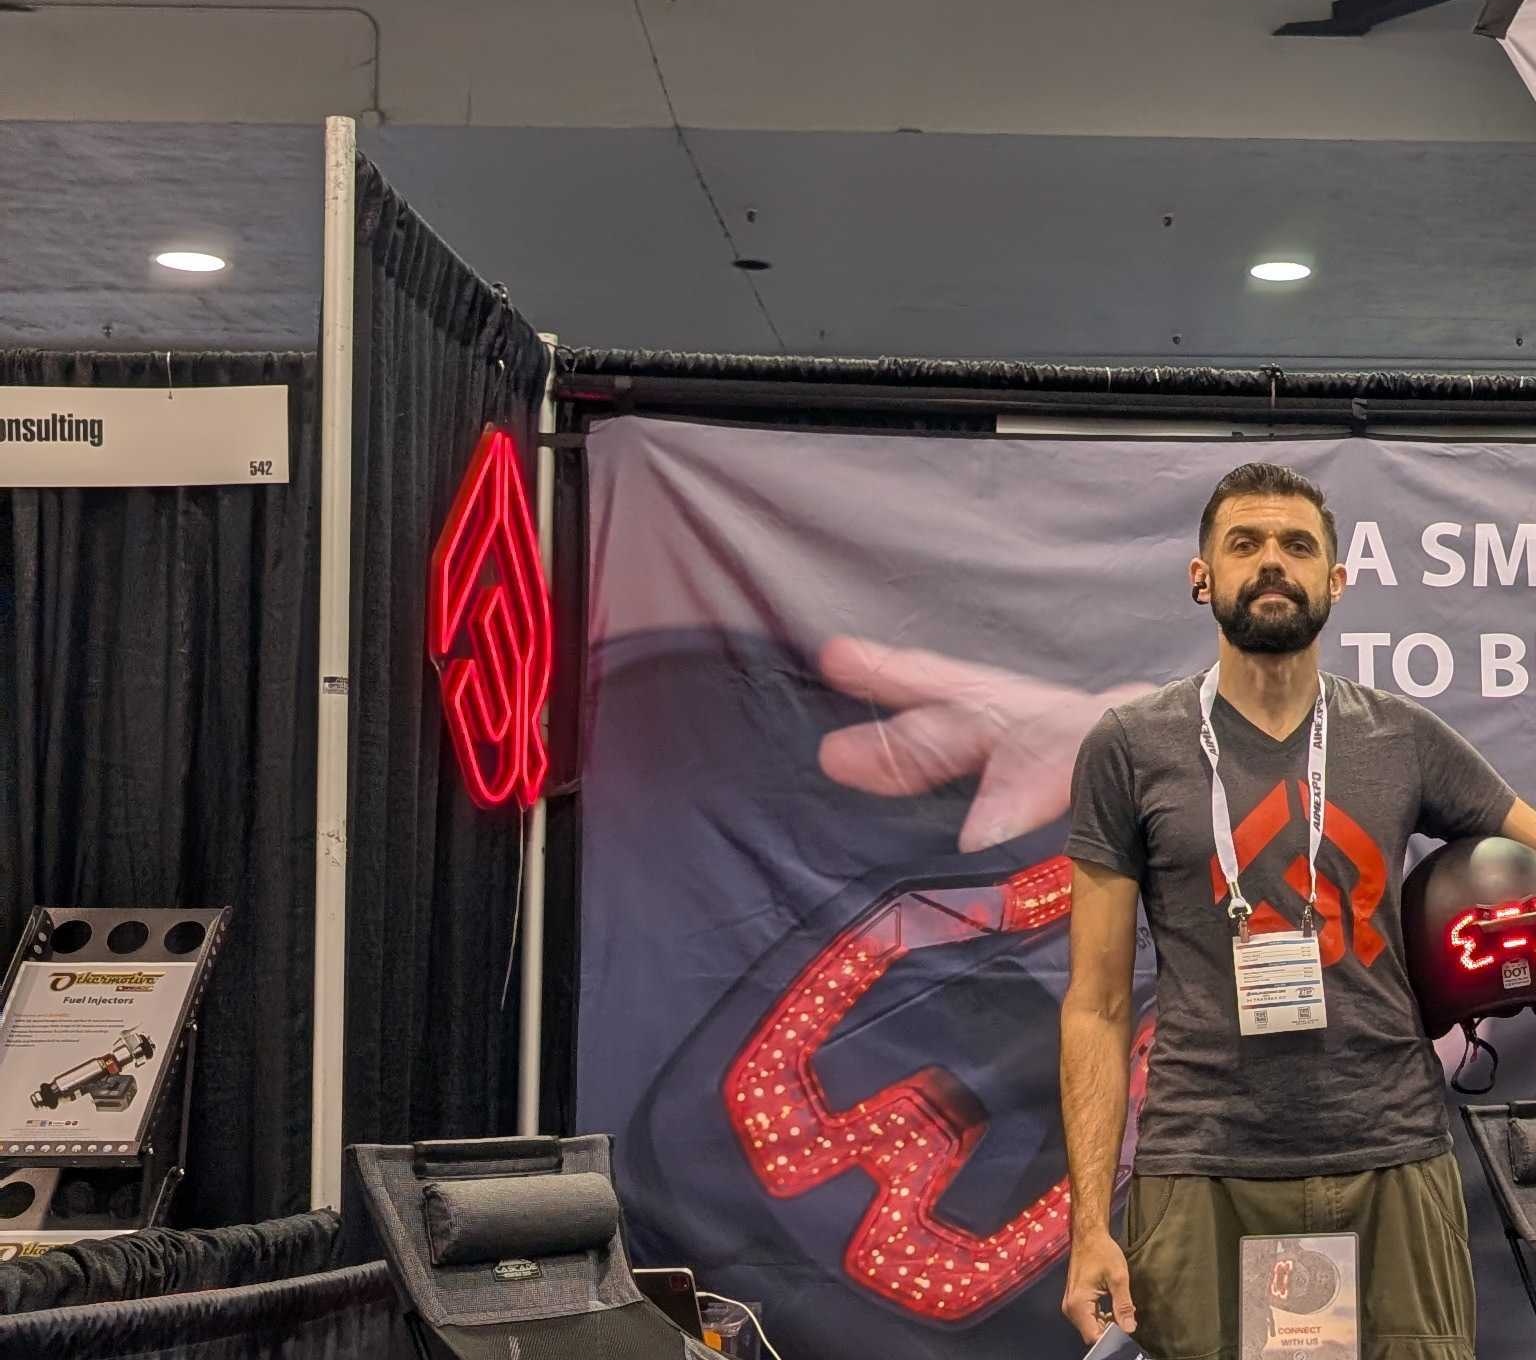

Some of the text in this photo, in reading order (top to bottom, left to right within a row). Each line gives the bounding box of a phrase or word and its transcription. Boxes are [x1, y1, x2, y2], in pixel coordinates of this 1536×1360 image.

[250, 460, 273, 476] 542
[1345, 521, 1399, 587] A
[1341, 632, 1454, 698] TO
[1312, 771, 1323, 832] AIMEXPO
[1504, 966, 1527, 979] DOT
[62, 996, 134, 1005] Fuel Injectors
[1278, 1326, 1322, 1335] CONNECT
[1281, 1337, 1319, 1347] WITH US
